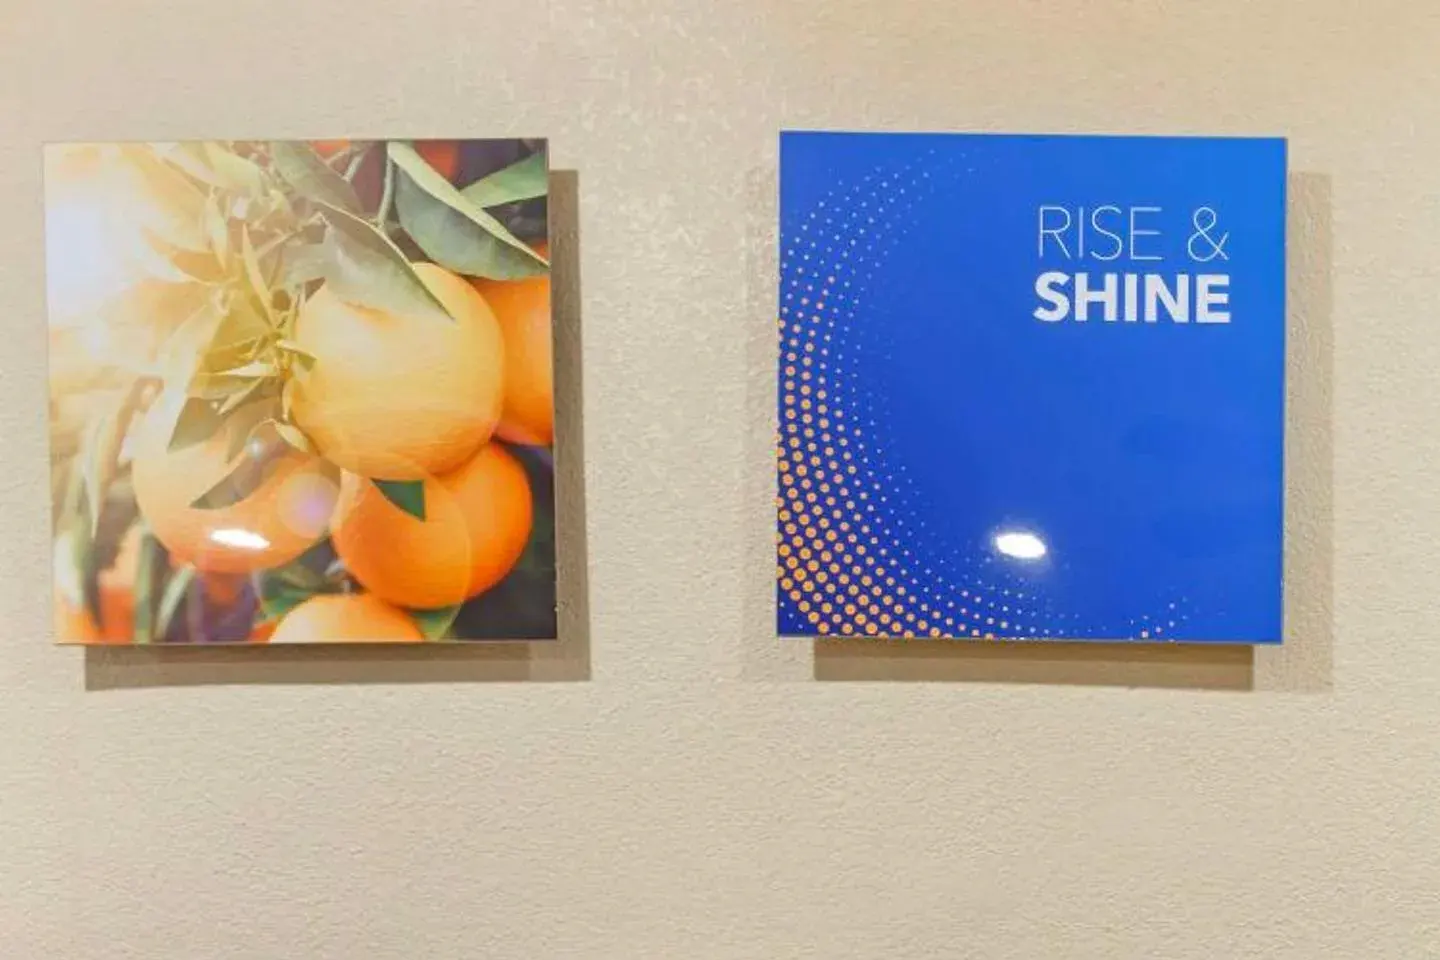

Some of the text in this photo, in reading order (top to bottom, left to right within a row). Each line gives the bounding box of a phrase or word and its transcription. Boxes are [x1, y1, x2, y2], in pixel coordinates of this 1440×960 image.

[1038, 205, 1230, 263] RISE &
[1033, 271, 1232, 324] SHINE
